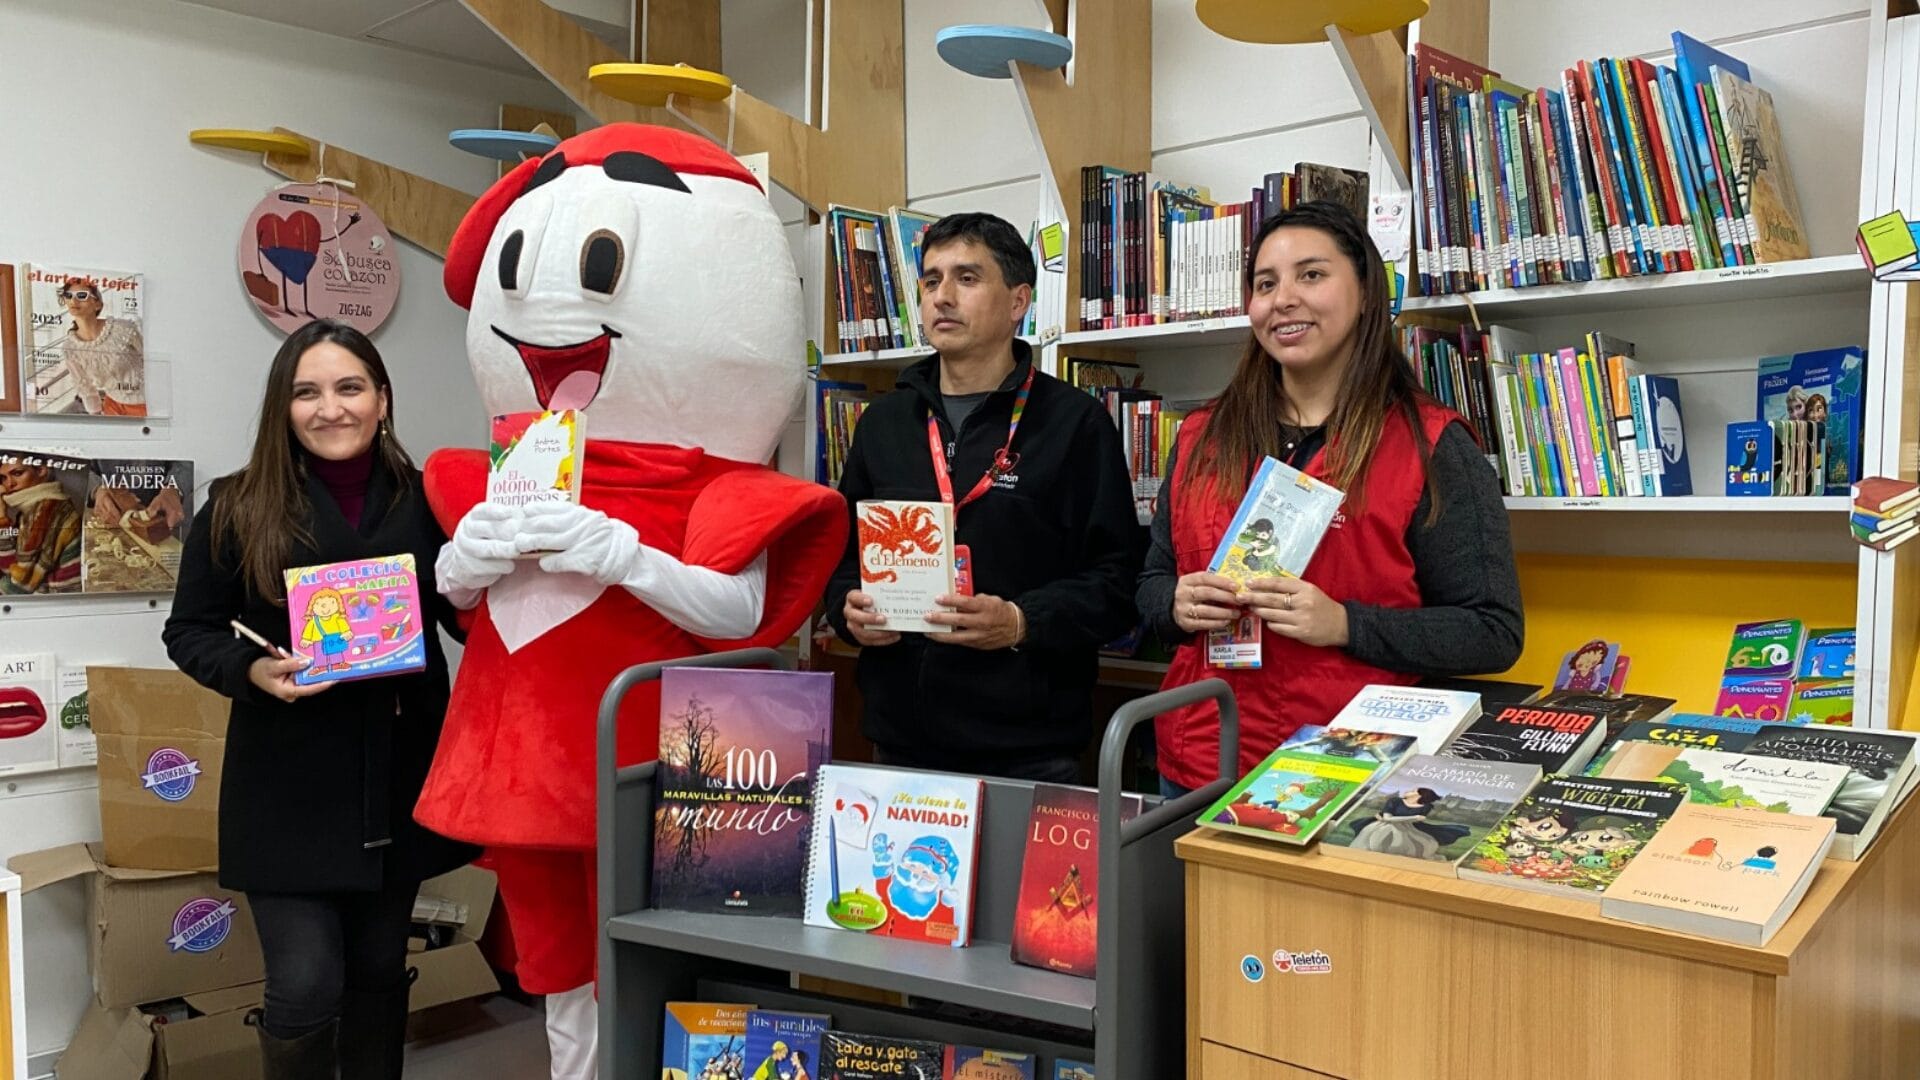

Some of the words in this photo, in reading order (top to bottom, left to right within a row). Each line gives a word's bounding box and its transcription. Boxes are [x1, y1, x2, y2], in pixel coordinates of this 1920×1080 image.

[346, 252, 391, 271] busca
[27, 270, 41, 282] el
[102, 277, 139, 291] tejer
[31, 313, 63, 325] 2023
[0, 455, 17, 465] te
[22, 456, 42, 466] de
[46, 459, 88, 471] tejer
[115, 465, 153, 474] TRABAJOS
[154, 466, 166, 474] EN
[101, 474, 179, 490] MADERA
[508, 470, 519, 481] El
[493, 476, 537, 494] otoño
[492, 491, 560, 507] mariposas
[870, 553, 881, 566] el
[884, 553, 940, 568] Elemento
[300, 572, 321, 587] AL
[326, 560, 403, 582] COLEGIO
[355, 575, 410, 593] MARTA
[4, 661, 35, 674] ART
[1360, 698, 1421, 713] BAJO
[1421, 704, 1450, 715] EL
[1361, 708, 1432, 722] HIELO
[1496, 708, 1596, 731] PERDIDA
[1519, 728, 1580, 744] GILLIAN
[1649, 728, 1720, 746] CAZA
[1804, 736, 1850, 747] HIJA
[1856, 743, 1885, 751] DEL
[1521, 740, 1572, 754] FLYNN
[1758, 741, 1895, 760] APOCALIPSIS
[153, 766, 192, 783] BOOKFAIL
[723, 745, 778, 791] 100
[1422, 764, 1437, 773] LA
[1440, 767, 1488, 780] ABADÍA
[1492, 773, 1511, 781] DE
[706, 777, 724, 788] LAS
[1407, 768, 1516, 789] NORTHANGER
[663, 790, 732, 801] MARAVILLAS
[737, 793, 803, 805] NATURALES
[676, 771, 807, 836] mundo
[917, 795, 950, 808] viene
[954, 797, 967, 810] la
[1561, 787, 1647, 810] WIGETTA
[887, 806, 969, 829] NAVIDAD!
[1036, 804, 1090, 820] FRANCISCO
[1650, 852, 1712, 867] eleanor
[1742, 867, 1781, 878] park
[1632, 888, 1691, 904] rainbow
[1694, 900, 1740, 913] rowell
[181, 910, 226, 942] BOOKFAIL
[1290, 951, 1329, 966] Teletón
[698, 1017, 709, 1026] de
[752, 1014, 826, 1034] insparables
[837, 1041, 873, 1056] Laura
[876, 1047, 884, 1059] y
[836, 1056, 848, 1069] al
[850, 1059, 902, 1073] rescate
